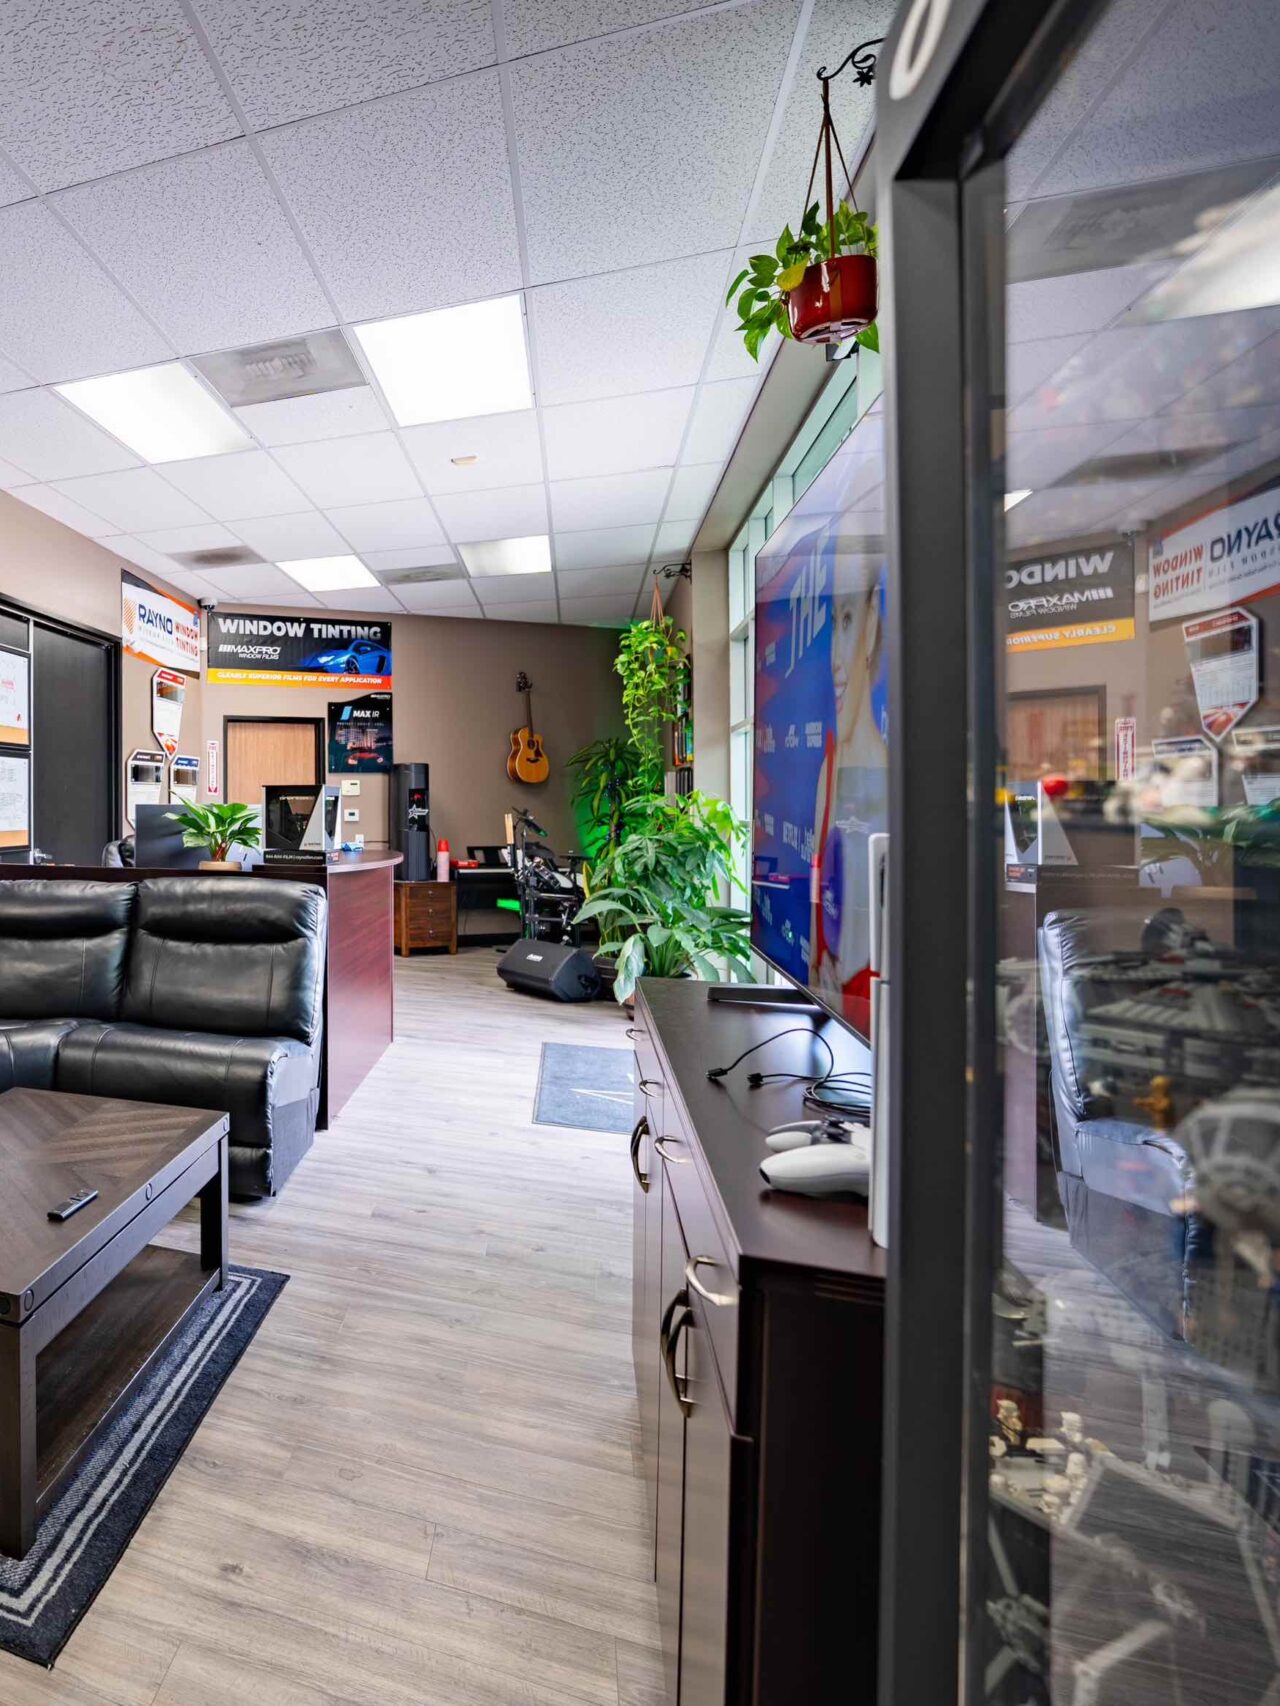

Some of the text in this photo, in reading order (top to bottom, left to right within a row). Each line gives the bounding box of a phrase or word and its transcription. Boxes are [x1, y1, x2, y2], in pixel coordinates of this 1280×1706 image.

[138, 603, 173, 635] RAYNO
[217, 618, 382, 640] WINDOW TINTING
[230, 645, 281, 655] MAXPRO
[339, 676, 382, 684] APPLICATION
[352, 710, 371, 718] MAX
